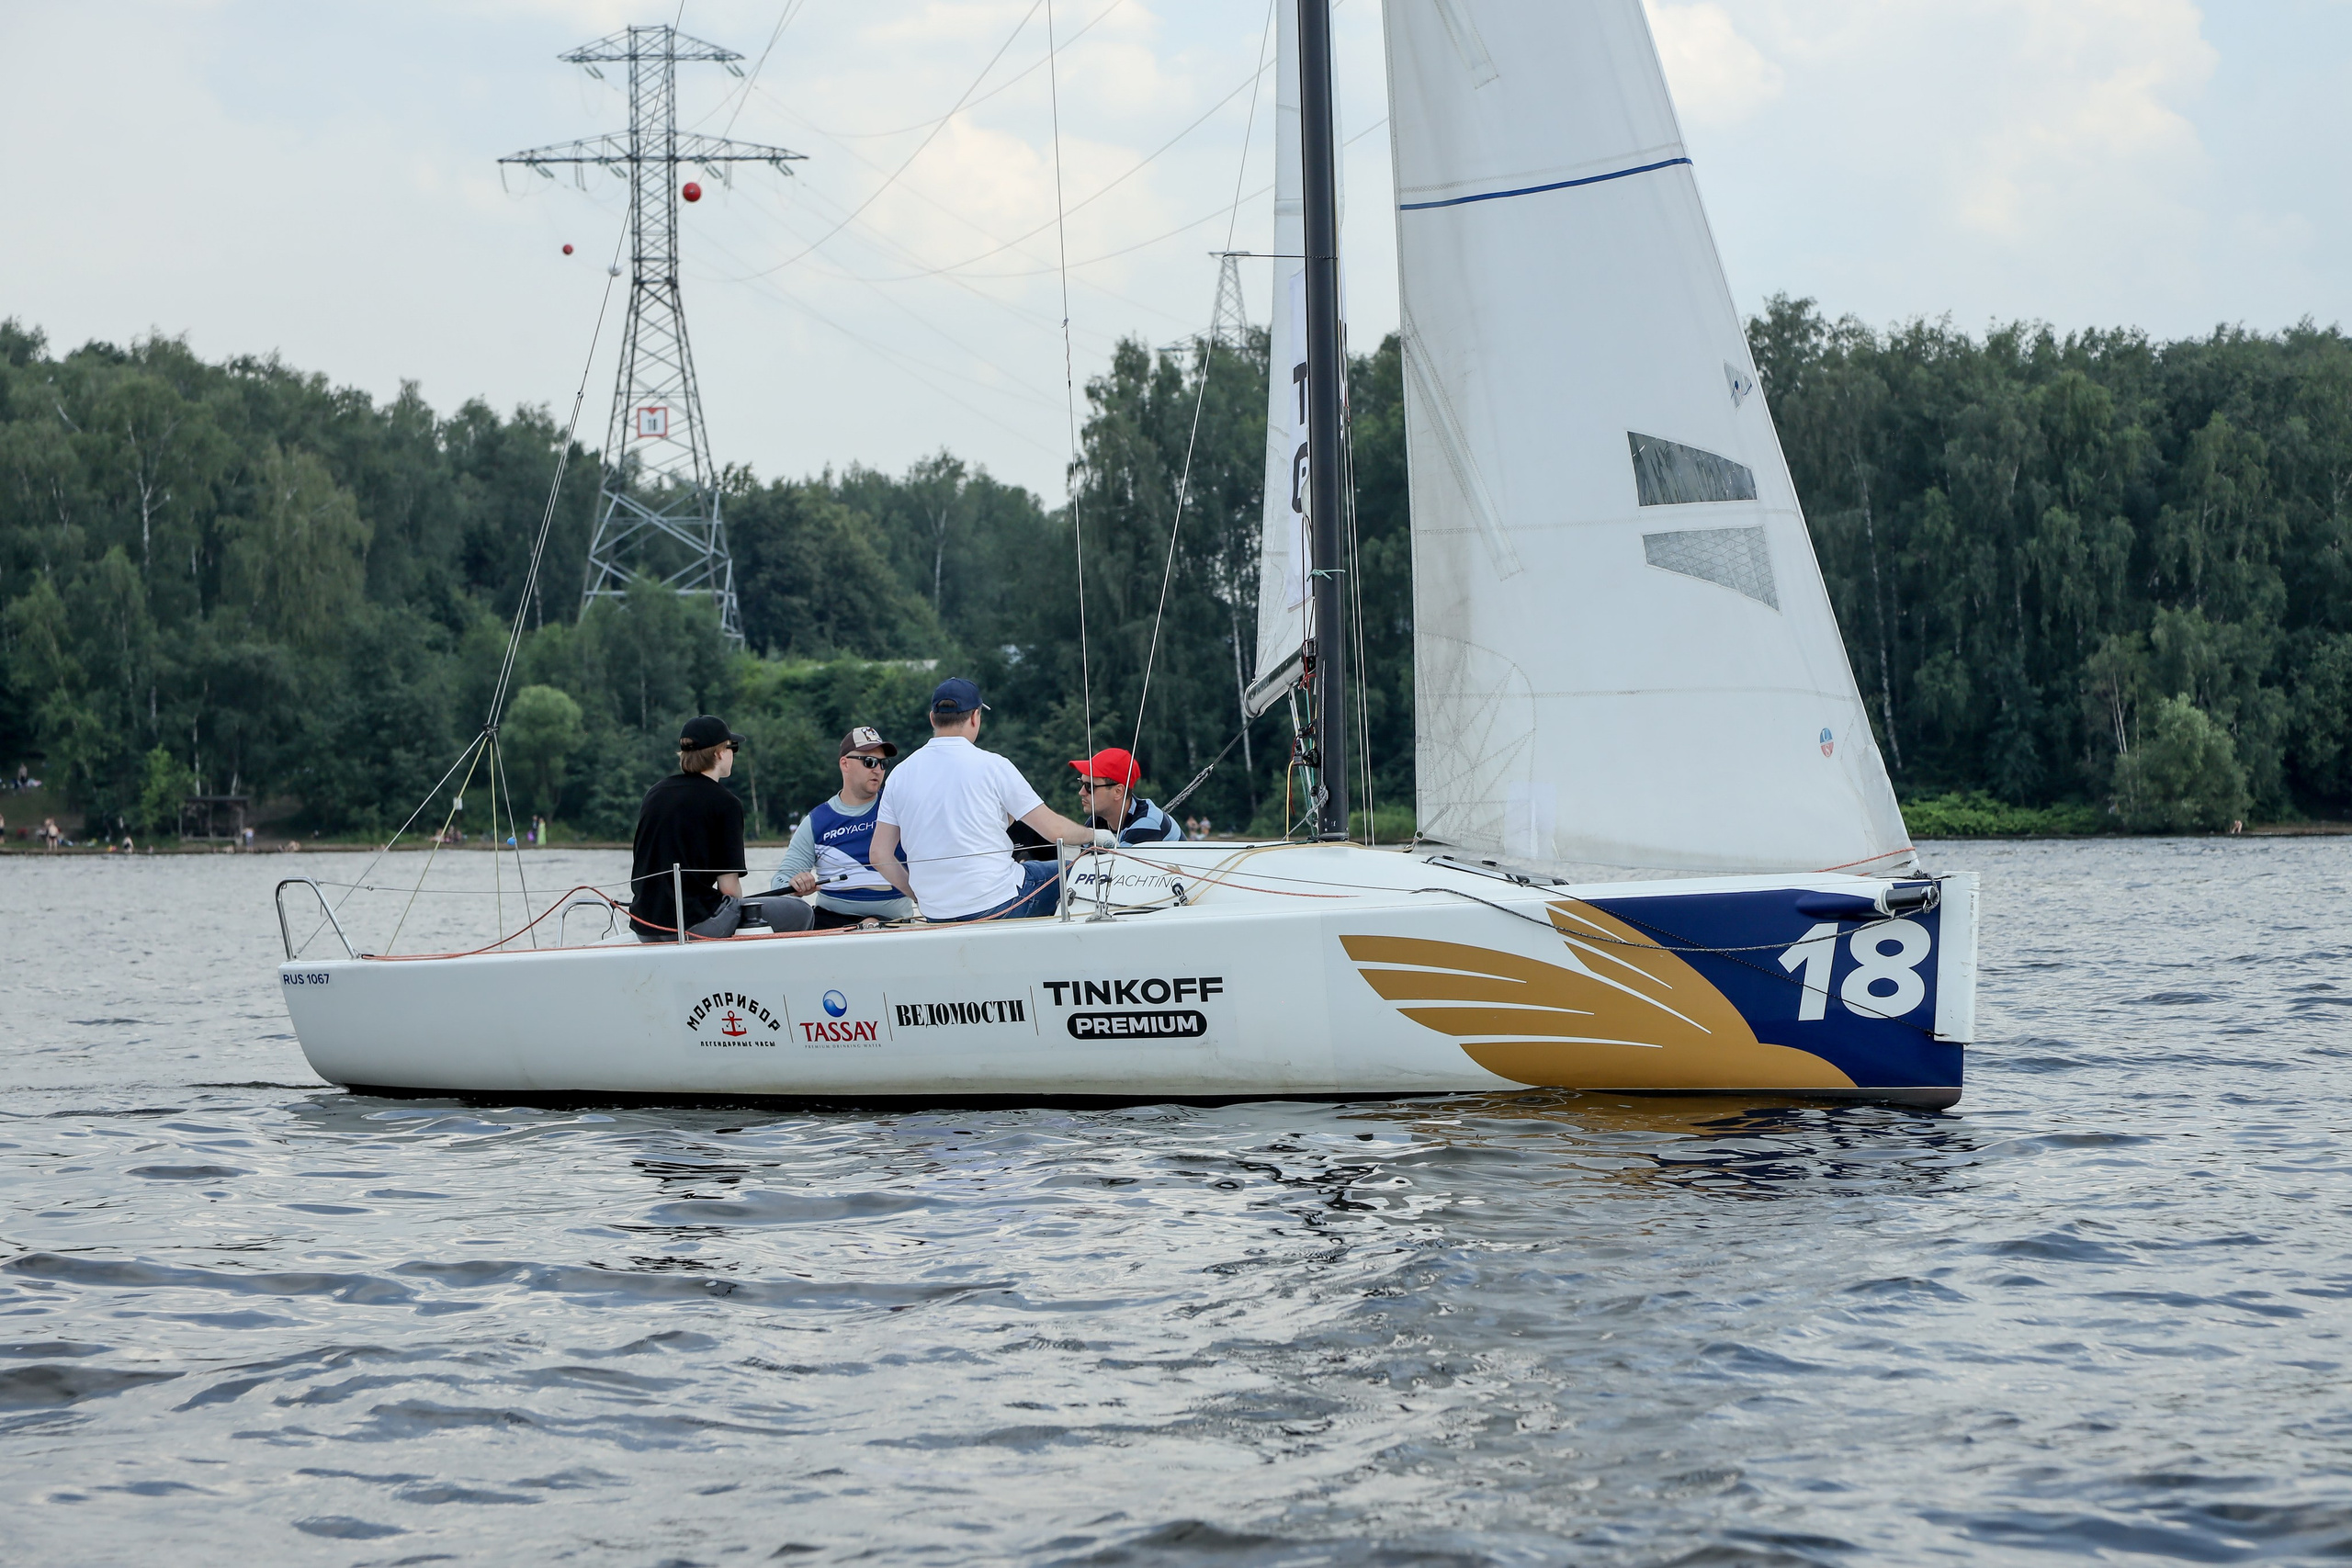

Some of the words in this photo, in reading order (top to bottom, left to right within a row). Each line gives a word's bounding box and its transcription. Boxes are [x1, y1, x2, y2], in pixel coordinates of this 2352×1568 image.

[823, 819, 877, 841] PROYACH
[283, 974, 305, 985] RUS
[306, 974, 330, 985] 1067
[1777, 919, 1931, 1021] 18
[1043, 976, 1224, 1007] TINKOFF
[686, 992, 781, 1032] МОРПРИБОР
[895, 999, 1026, 1029] ВЕДОМОСТИ
[1075, 1015, 1199, 1035] PREMIUM
[799, 1021, 878, 1043] TASSAY
